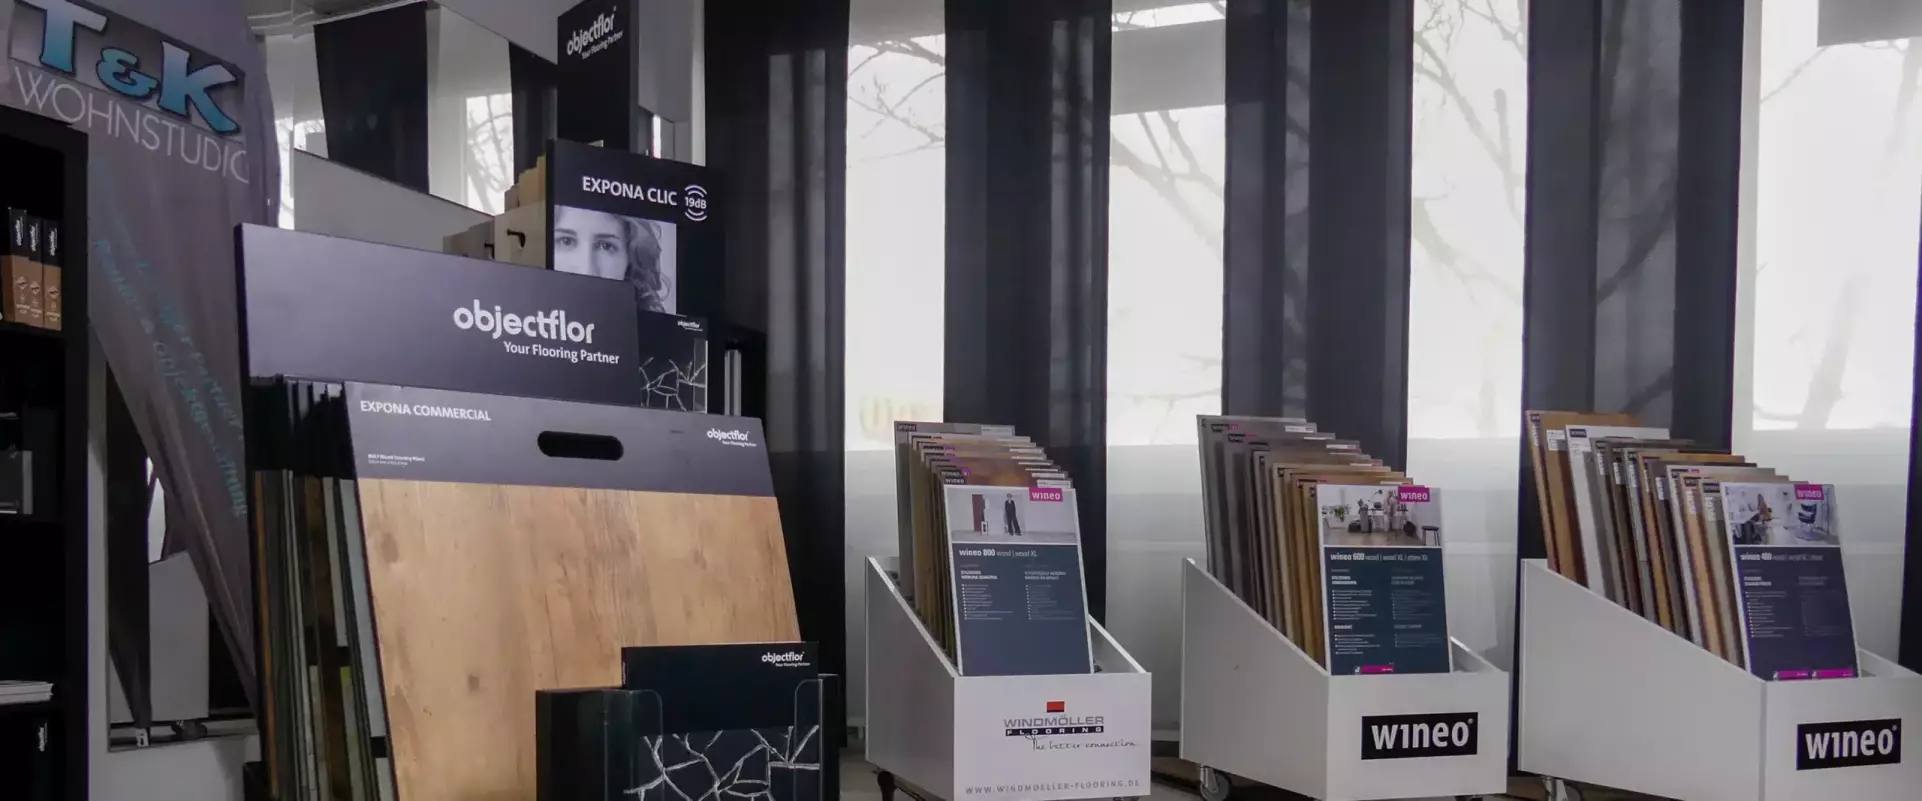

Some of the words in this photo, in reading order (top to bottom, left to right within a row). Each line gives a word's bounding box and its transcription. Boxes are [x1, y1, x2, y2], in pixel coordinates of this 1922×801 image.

[566, 12, 615, 56] objectflor
[582, 175, 645, 201] EXPONA
[647, 187, 678, 206] CLIC
[684, 196, 707, 210] 19dB
[453, 299, 595, 344] objectflor
[503, 340, 531, 355] Your
[532, 344, 578, 364] Flooring
[580, 350, 620, 365] Partner
[360, 400, 412, 415] EXPONA
[413, 405, 492, 421] COMMERCIAL
[706, 428, 749, 441] objectflor
[1031, 491, 1062, 501] wineo
[1400, 491, 1429, 501] wineo
[959, 548, 982, 557] wineo
[982, 548, 996, 557] 800
[1330, 552, 1352, 561] wineo
[762, 651, 804, 664] objectflor
[1004, 715, 1105, 728] WINDMÖLLER
[1006, 727, 1102, 736] FLOORING
[1371, 721, 1470, 750] wineo
[1085, 738, 1137, 749] connection
[1805, 728, 1894, 760] wineo
[965, 779, 1141, 795] WWW.WINDMOELLER-FLOORING.DE
